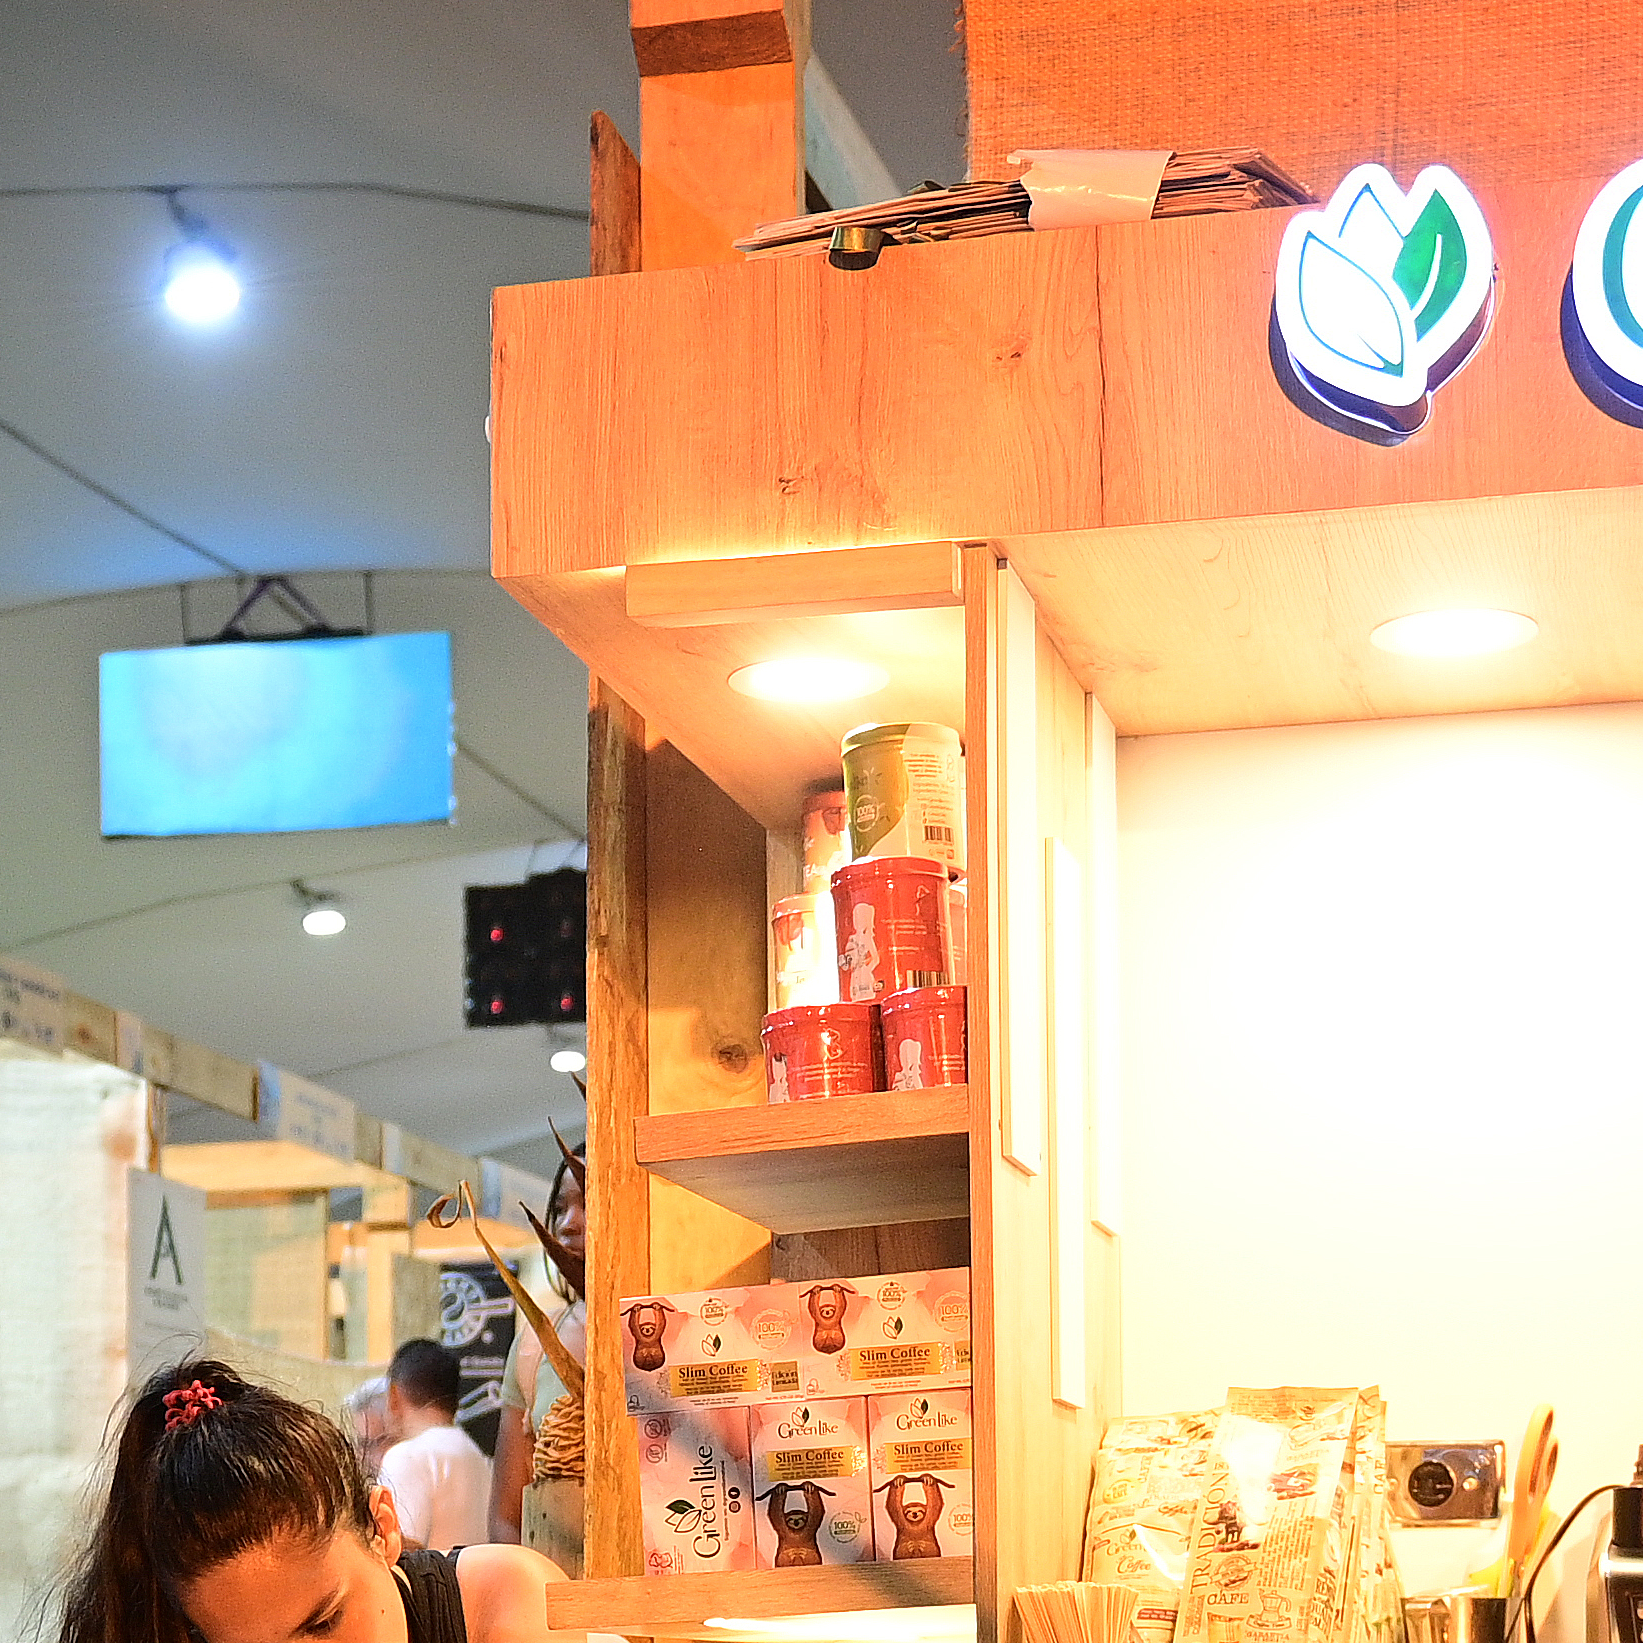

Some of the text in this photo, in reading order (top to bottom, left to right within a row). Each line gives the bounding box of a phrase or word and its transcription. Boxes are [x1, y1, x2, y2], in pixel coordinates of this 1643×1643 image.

[859, 1346, 931, 1361] Slim Coffee
[678, 1363, 748, 1379] Slim Coffee
[893, 1441, 964, 1455] Slim Coffee
[775, 1450, 844, 1463] Slim Coffee
[833, 1520, 856, 1529] 100%
